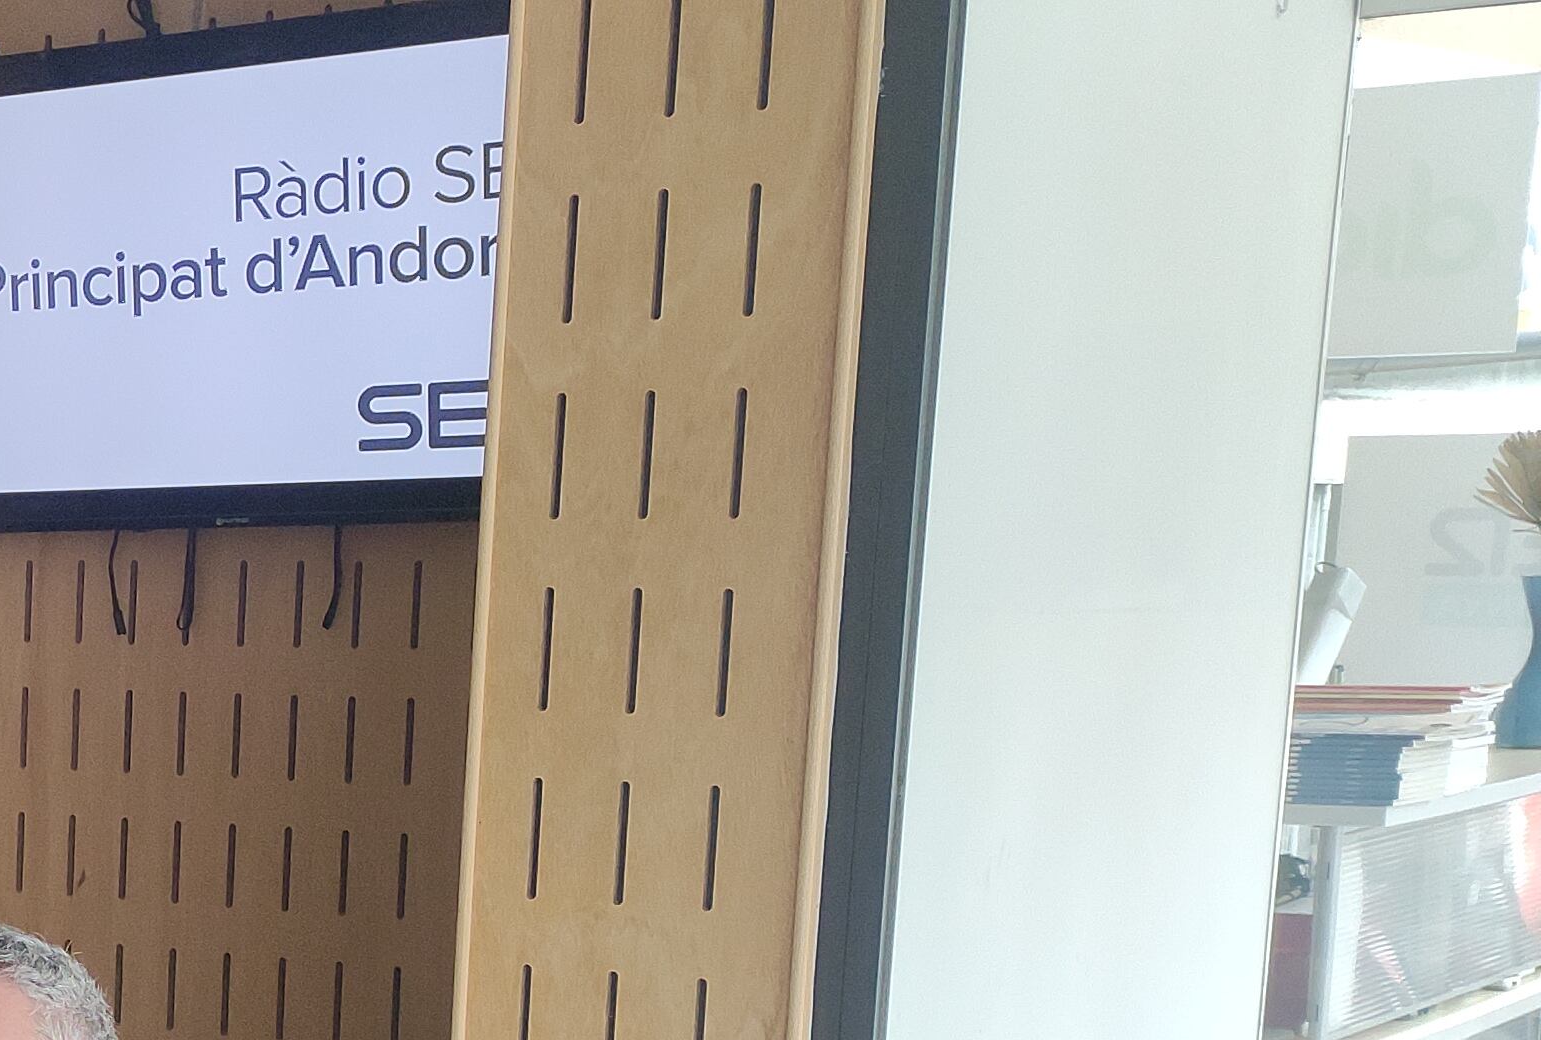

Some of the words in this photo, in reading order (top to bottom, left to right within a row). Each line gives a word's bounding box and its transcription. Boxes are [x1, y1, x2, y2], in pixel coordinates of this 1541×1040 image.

[234, 156, 411, 222] Ràdio
[434, 141, 504, 203] SE
[357, 379, 490, 452] SE
